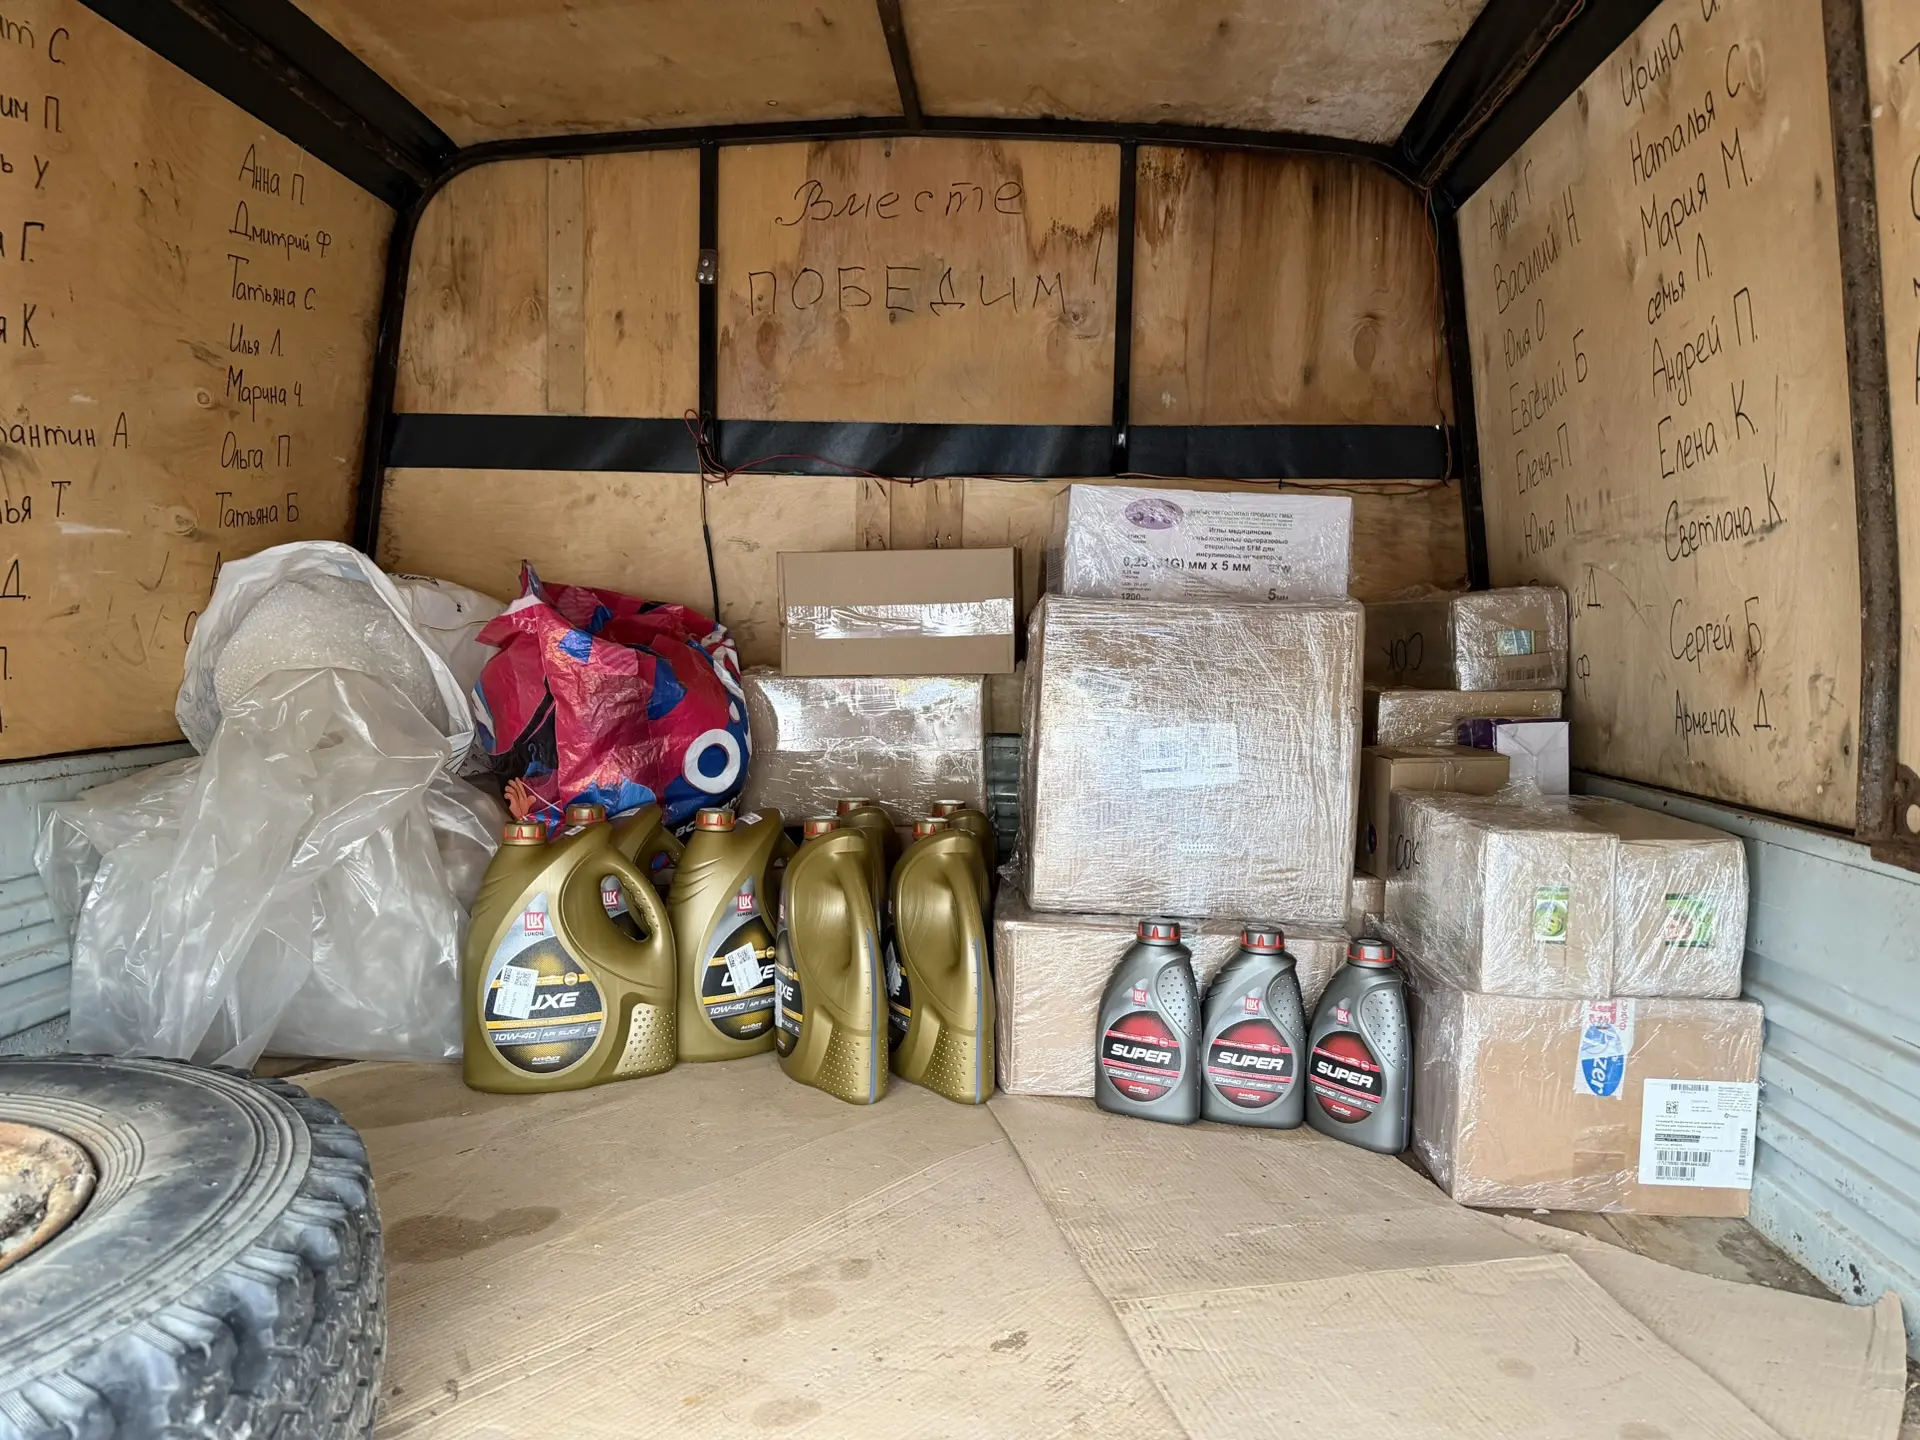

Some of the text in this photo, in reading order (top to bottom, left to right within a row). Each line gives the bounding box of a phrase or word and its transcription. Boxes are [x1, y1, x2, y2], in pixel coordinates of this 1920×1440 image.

[1619, 22, 1685, 114] Ирина
[1629, 43, 1747, 187] Наталья С.
[238, 143, 281, 197] Анна
[1639, 126, 1753, 257] Мария М.
[774, 179, 1023, 227] Вместе
[1489, 190, 1519, 250] Анна
[228, 200, 311, 262] Дмитрий
[227, 253, 316, 311] Татьяна С.
[1492, 223, 1559, 316] Василий
[1647, 231, 1713, 325] семья Л.
[228, 321, 284, 357] Илья Л.
[1503, 328, 1532, 373] Юлия
[1652, 286, 1759, 407] Андрей П.
[225, 364, 288, 423] Марина
[1508, 359, 1568, 436] Евгений
[112, 411, 132, 450] А.
[220, 430, 264, 470] Ольга
[1657, 378, 1760, 480] Елена К.
[0, 480, 72, 524] ья Т.
[214, 491, 279, 529] Татьяна
[1228, 528, 1272, 536] медицинские
[1522, 511, 1557, 559] Юлия
[1664, 499, 1756, 562] Светлана
[1221, 560, 1229, 572] 5
[1669, 595, 1766, 675] Сергей Б.
[1674, 687, 1777, 758] Арменак Д.
[710, 1002, 746, 1015] 10W-40
[494, 1031, 537, 1041] 10W-40
[1110, 1043, 1172, 1065] SUPER
[1217, 1051, 1285, 1071] SUPER
[1215, 1076, 1242, 1086] 10W-40
[1316, 1060, 1374, 1089] SUPER
